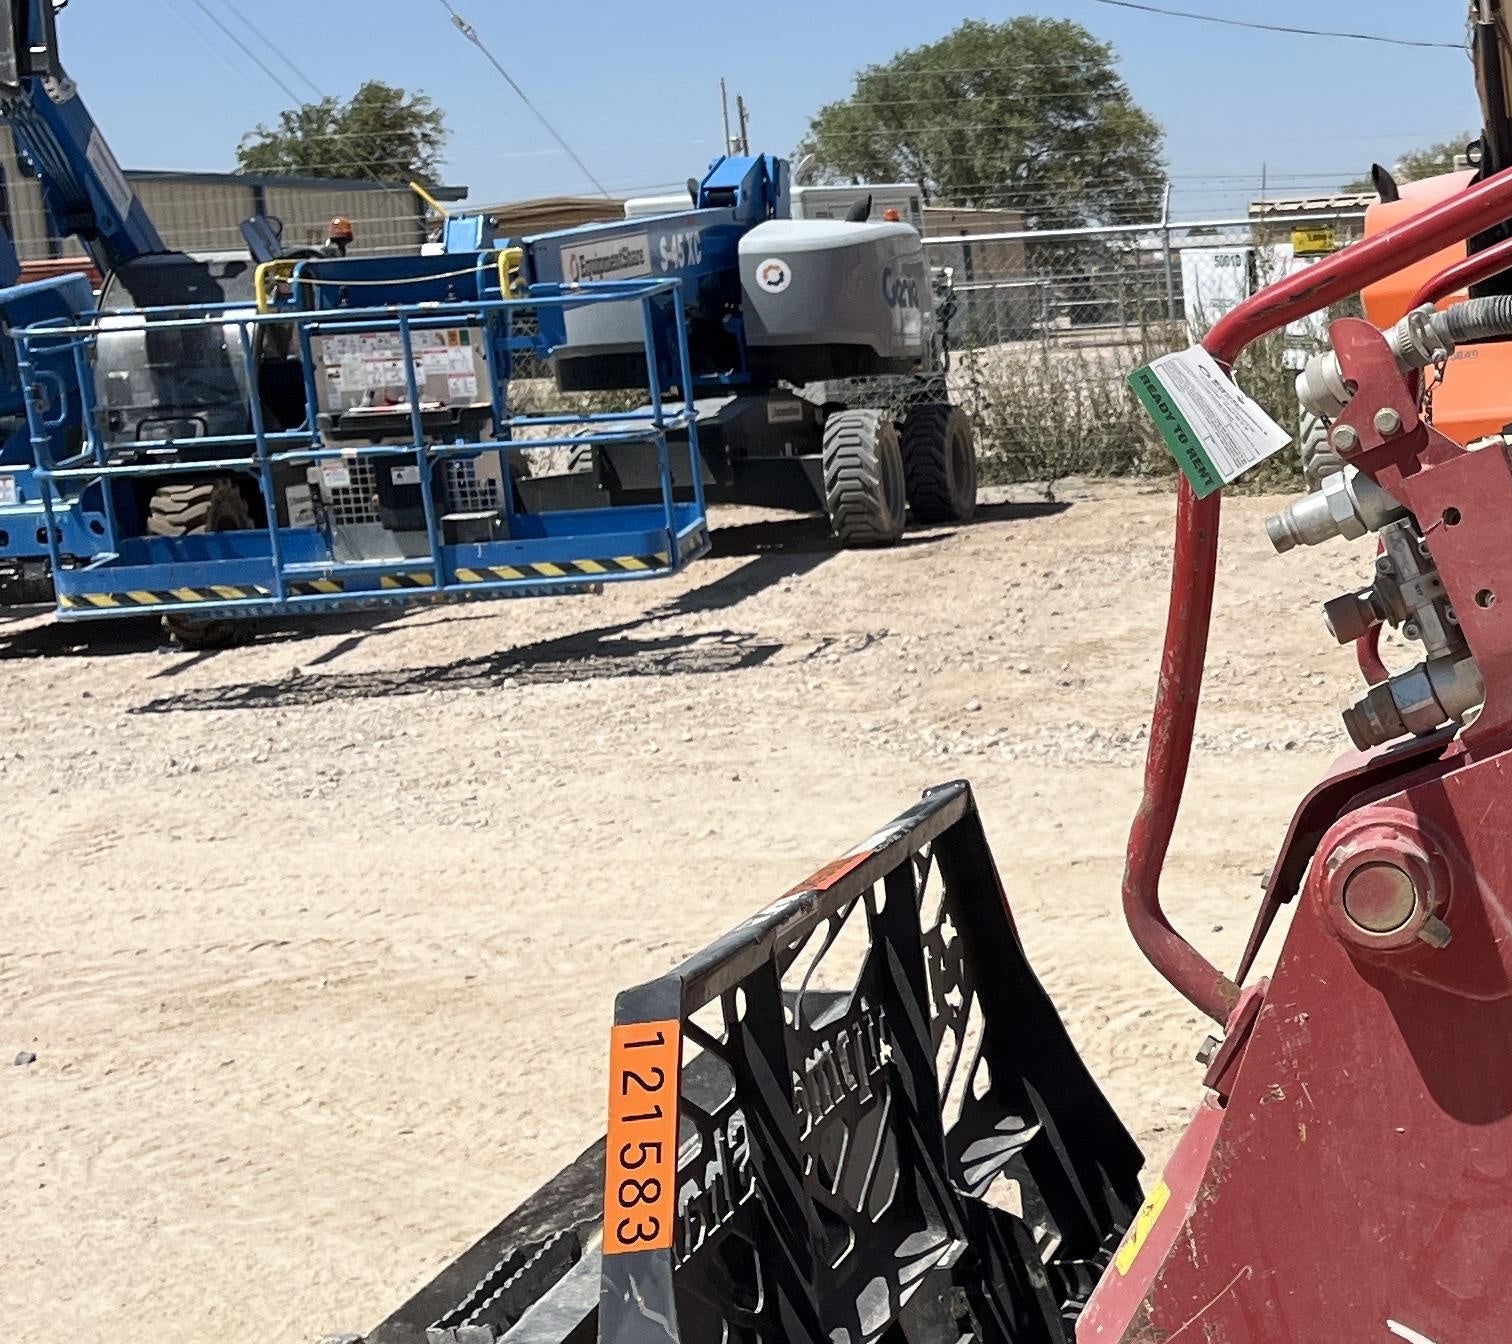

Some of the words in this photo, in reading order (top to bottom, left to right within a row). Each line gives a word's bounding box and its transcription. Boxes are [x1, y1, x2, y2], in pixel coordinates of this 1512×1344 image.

[1138, 373, 1176, 423] READY
[1173, 423, 1189, 445] TO
[1185, 447, 1216, 487] RENT
[616, 1031, 665, 1245] 121583
